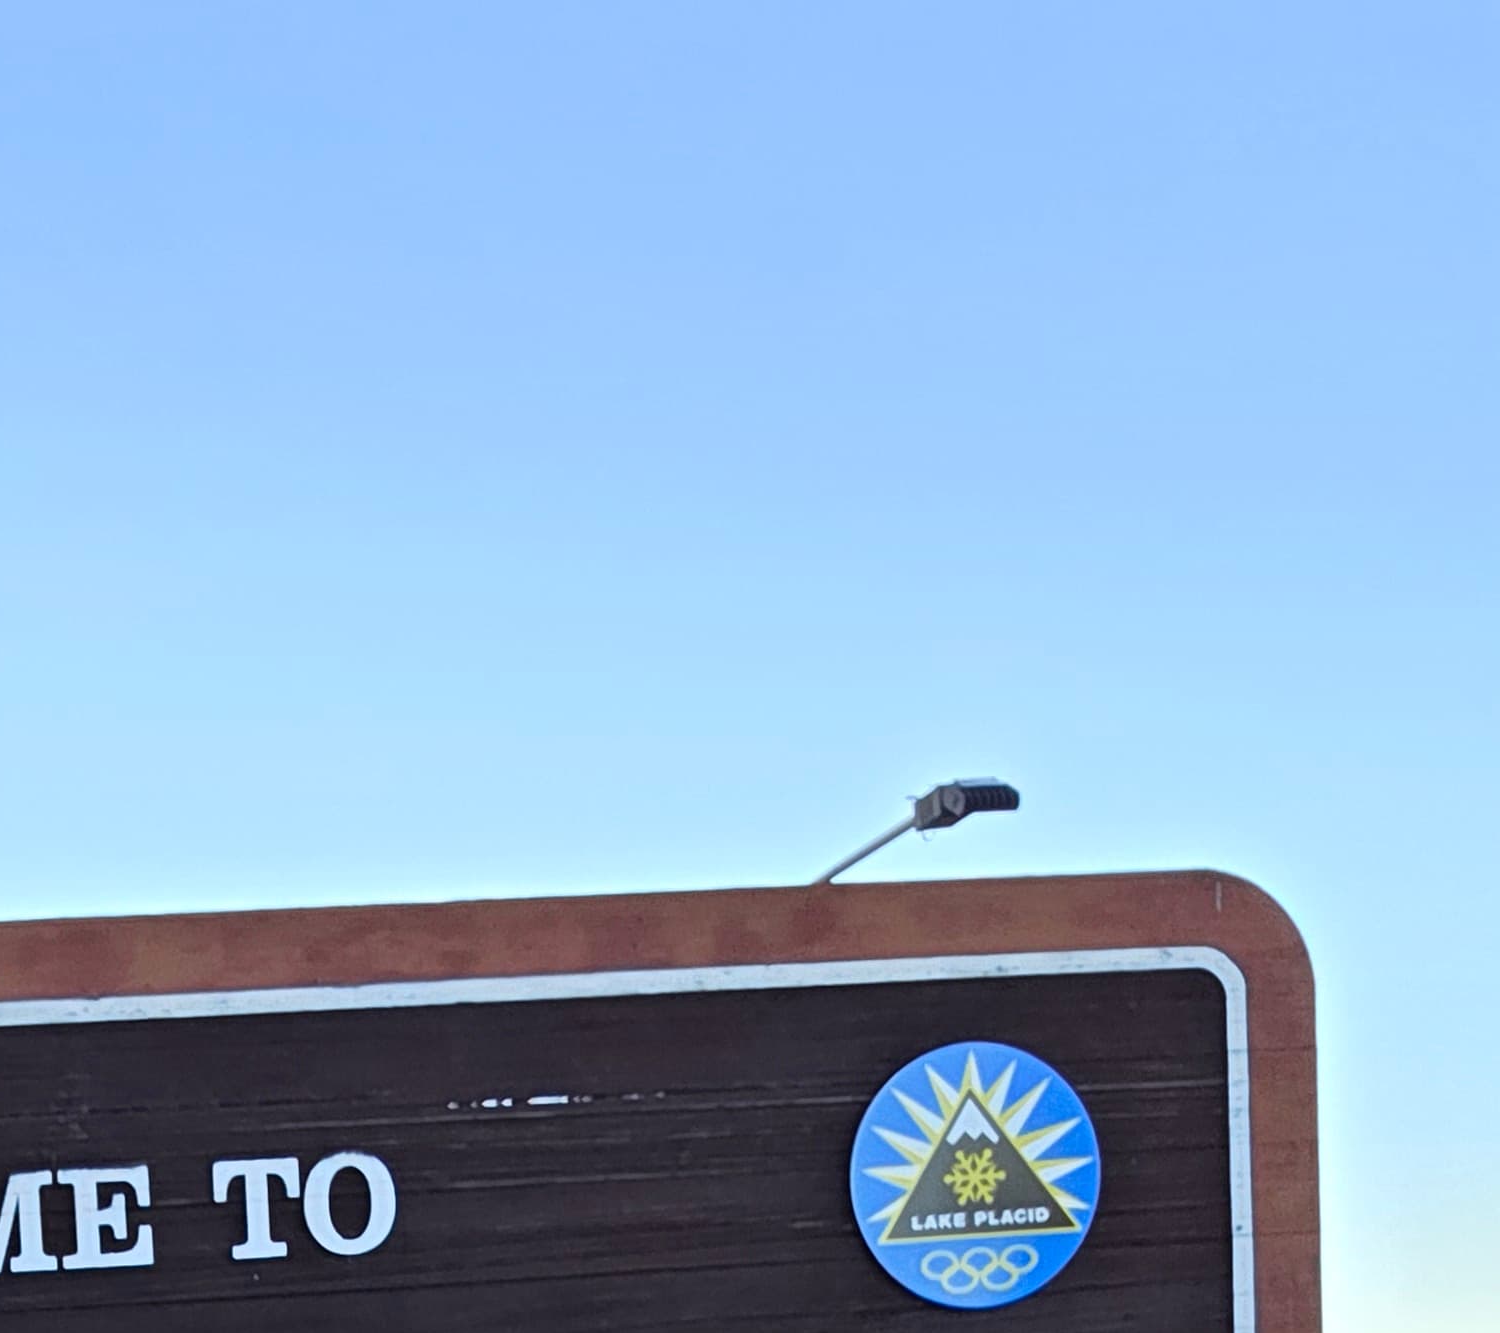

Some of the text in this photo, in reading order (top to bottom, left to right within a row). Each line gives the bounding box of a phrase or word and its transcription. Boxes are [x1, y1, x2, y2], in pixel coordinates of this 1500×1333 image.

[212, 1151, 397, 1260] TO
[911, 1206, 1050, 1231] LAKE PLACID
